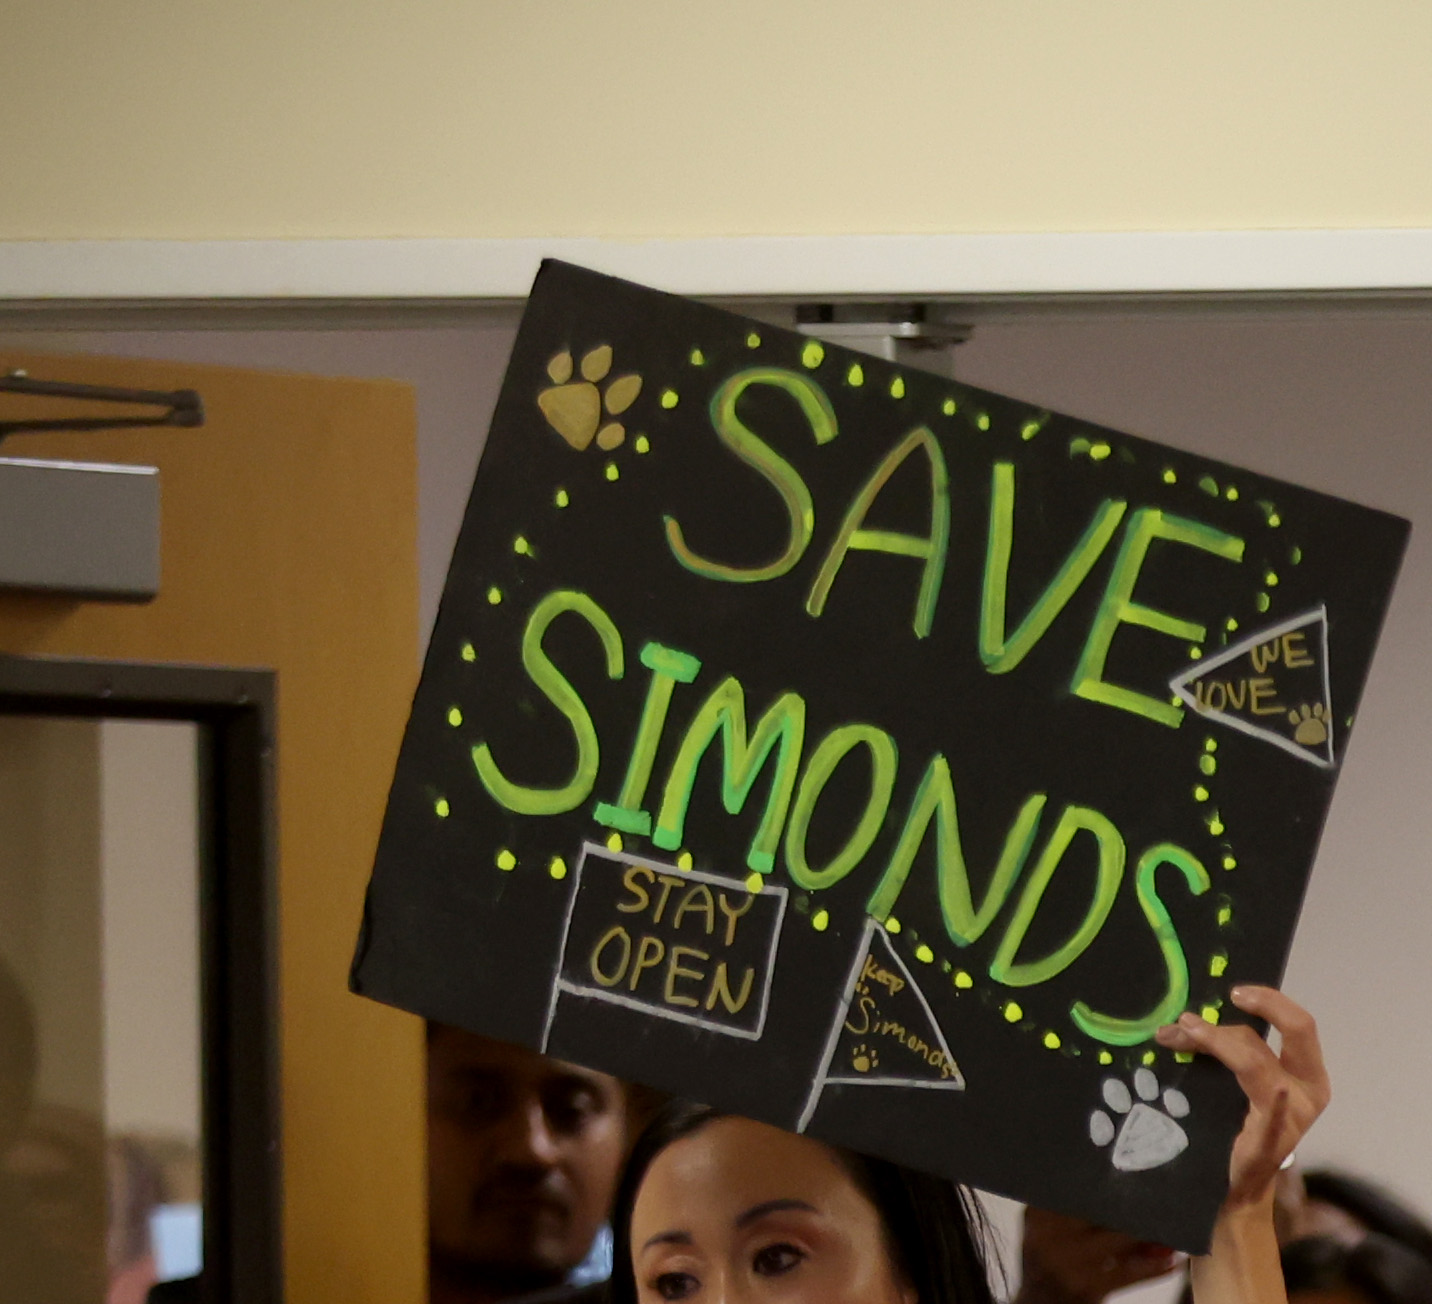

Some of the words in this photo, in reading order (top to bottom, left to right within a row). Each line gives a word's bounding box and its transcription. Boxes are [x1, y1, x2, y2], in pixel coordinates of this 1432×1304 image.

[664, 366, 1245, 727] SAVE
[1251, 632, 1315, 673] WE
[471, 589, 1210, 1047] SIMONDS
[616, 865, 757, 946] STAY
[590, 926, 755, 1014] OPEN
[845, 997, 959, 1079] Simonds
